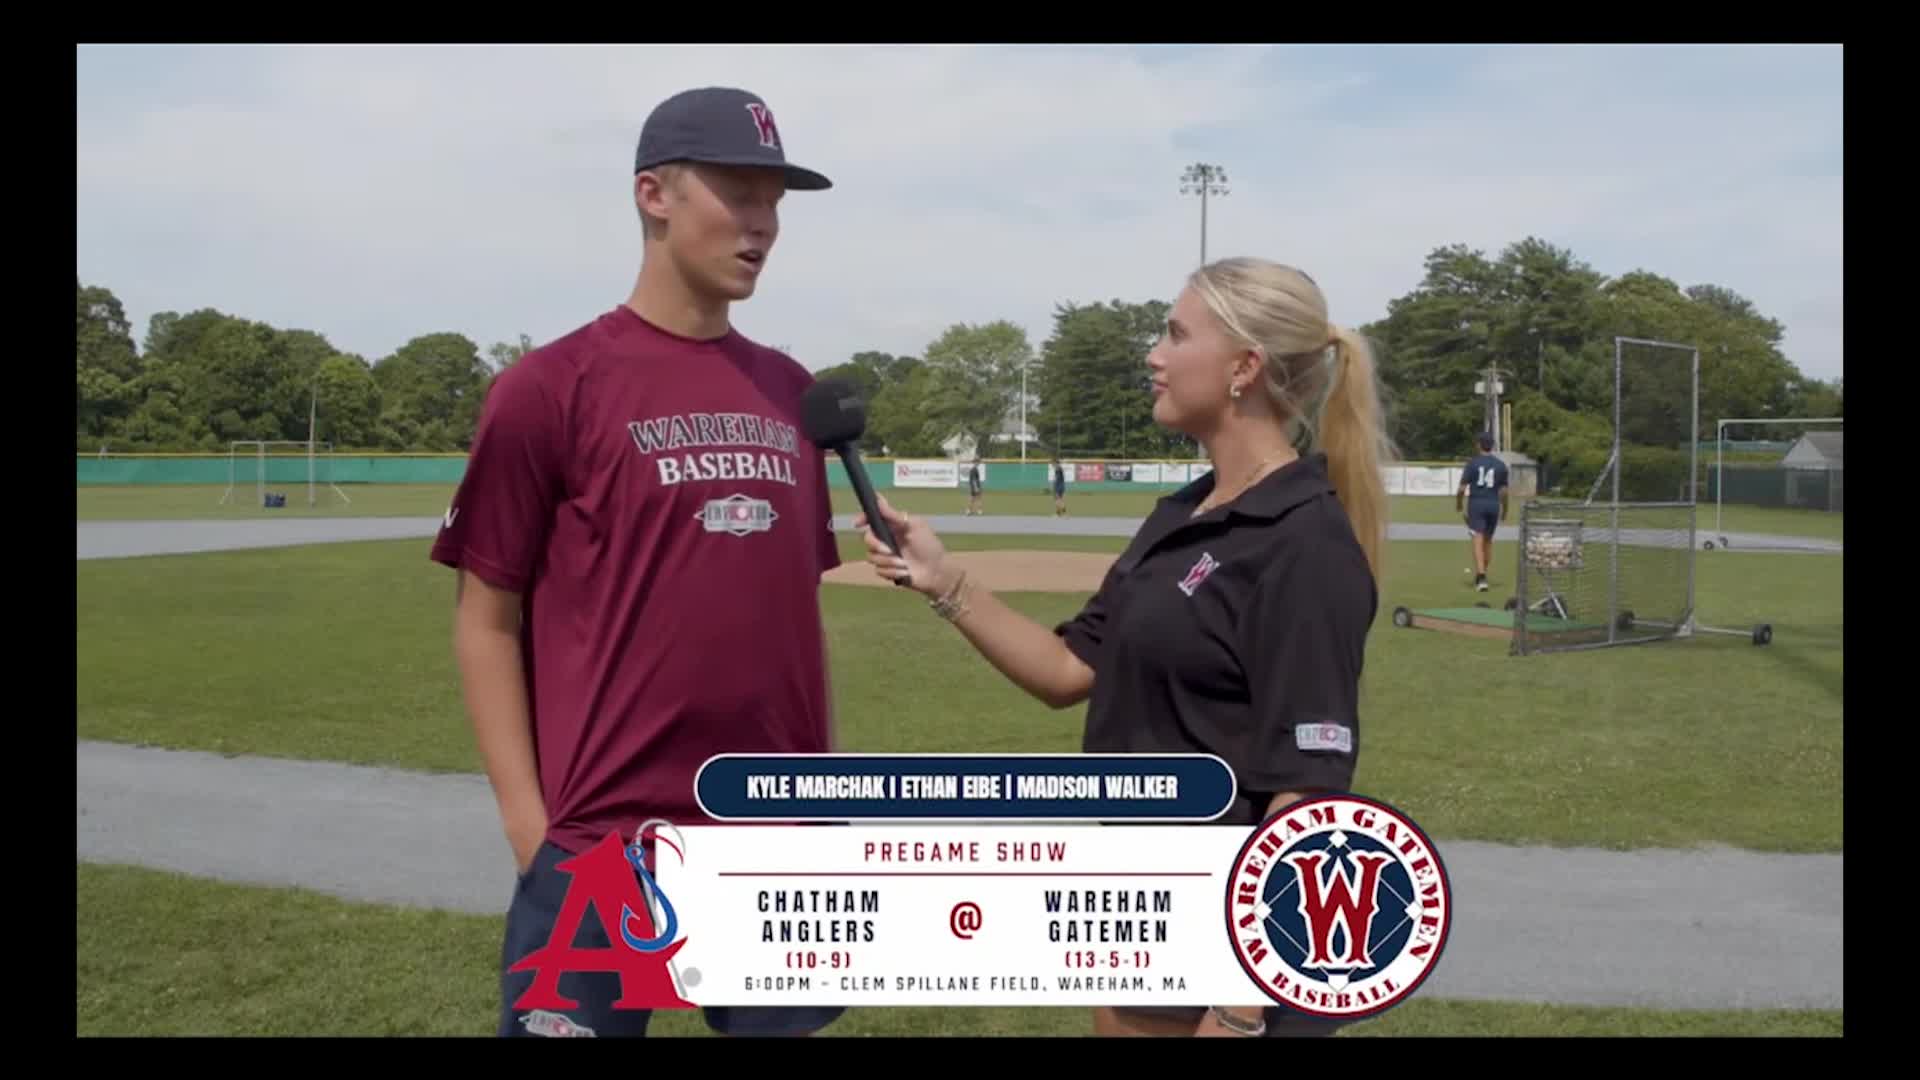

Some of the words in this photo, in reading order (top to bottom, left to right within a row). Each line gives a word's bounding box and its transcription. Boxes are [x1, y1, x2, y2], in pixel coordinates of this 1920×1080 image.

[744, 102, 779, 151] W
[627, 412, 800, 458] WAREHAM
[656, 451, 797, 486] BASEBALL
[1476, 466, 1495, 488] 14
[1177, 551, 1221, 597] W
